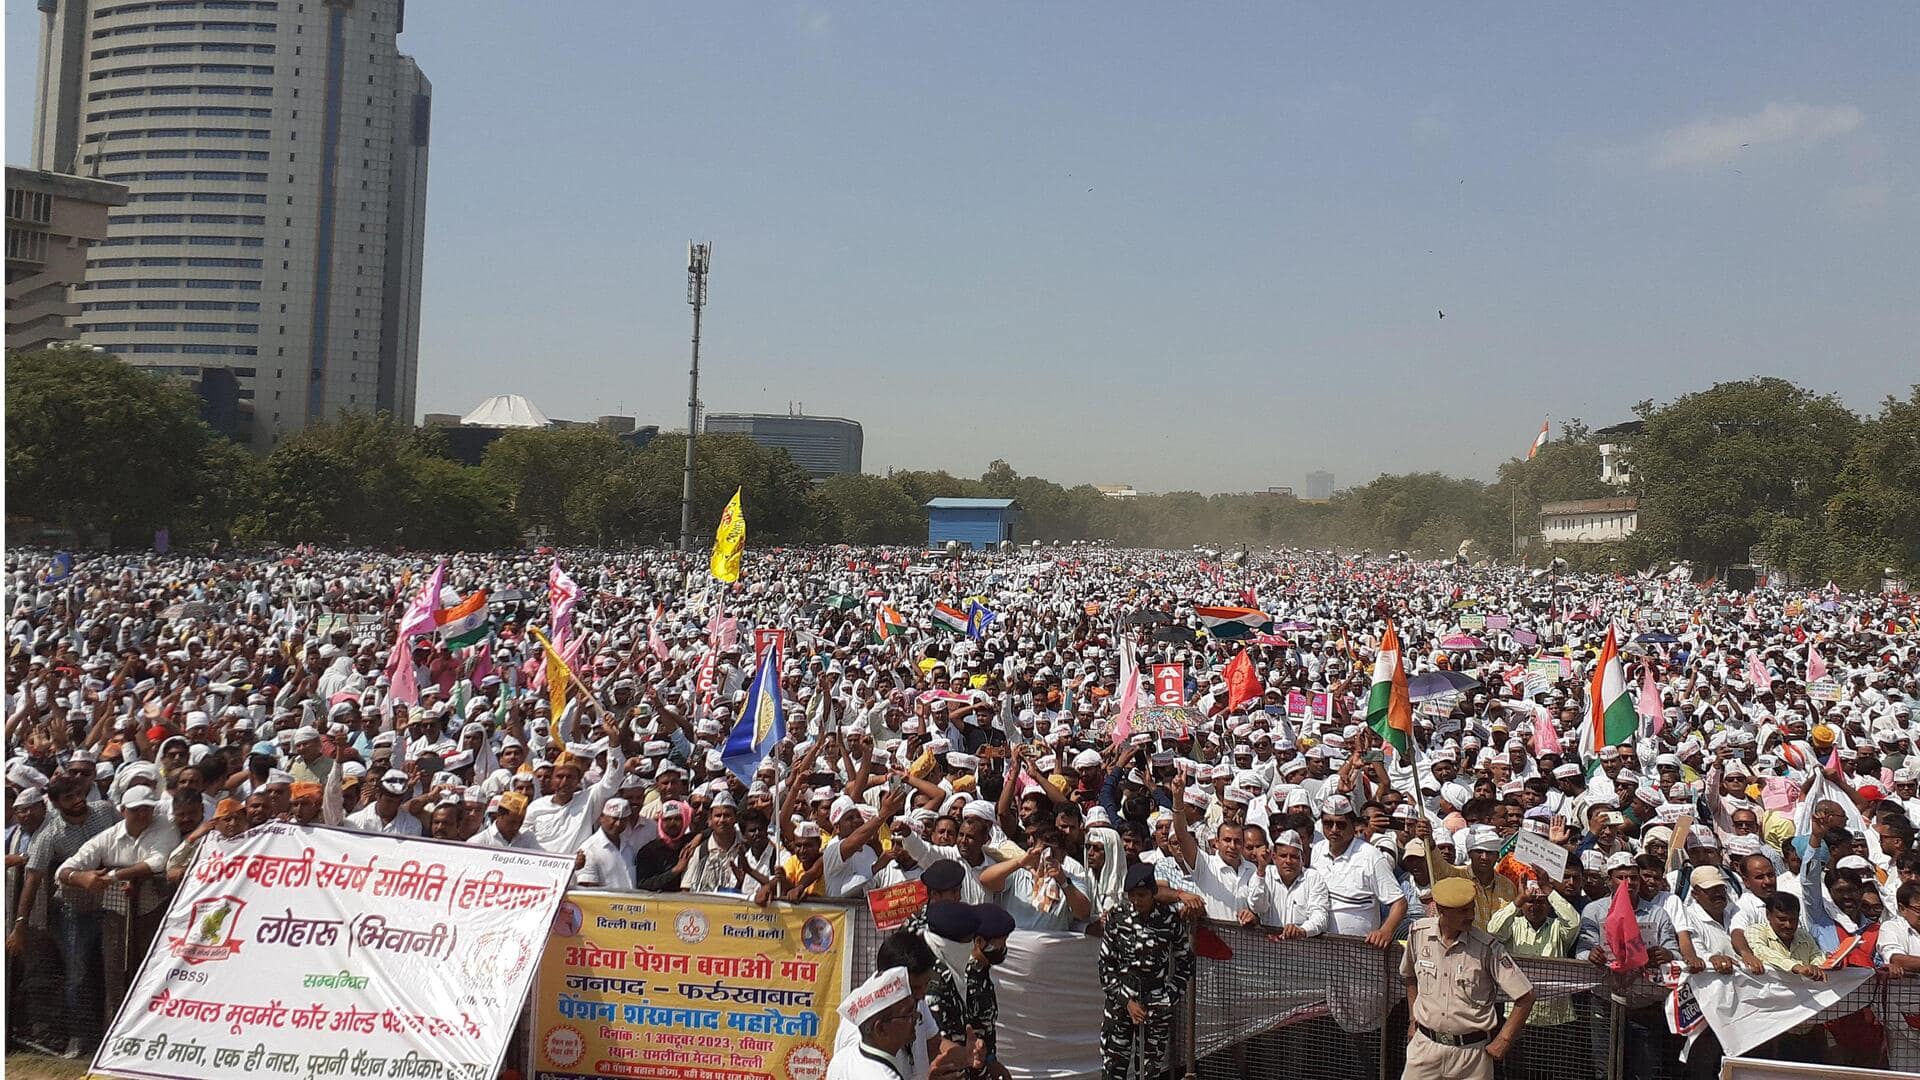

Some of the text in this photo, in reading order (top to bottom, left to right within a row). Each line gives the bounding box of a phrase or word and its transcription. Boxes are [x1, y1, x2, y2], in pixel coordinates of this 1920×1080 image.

[1157, 666, 1180, 707] AIC
[246, 847, 316, 888] बहाली
[316, 853, 379, 893] संघर्ष
[373, 859, 448, 902] समिति
[256, 907, 458, 962] लोहारू (भिवानी)
[596, 917, 627, 930] दिल्ली
[723, 925, 754, 938] दिल्ली
[565, 941, 819, 983] अटेवा पेंशन बचाओ मंच
[165, 968, 209, 985] (PBSS)
[303, 969, 369, 990] सम्बन्धित
[566, 974, 647, 996] जनपद
[226, 1000, 288, 1035] मूवमेंट
[291, 1002, 331, 1031] फॉर
[329, 1002, 379, 1034] ओल्ड
[557, 993, 618, 1023] पेंशन
[624, 998, 721, 1031] शंखनाद
[644, 1032, 651, 1043] 1
[698, 1036, 734, 1051] 2023,
[739, 1037, 774, 1052] रविवार
[144, 1033, 168, 1061] ही
[167, 1037, 207, 1067] मांग,
[213, 1047, 245, 1068] एक
[243, 1042, 265, 1072] ही
[264, 1051, 300, 1075] नारा,
[304, 1048, 349, 1080] पुरानी
[387, 1050, 444, 1080] अधिकार
[642, 1047, 690, 1064] रामलीला
[730, 1053, 763, 1069] दिल्ली
